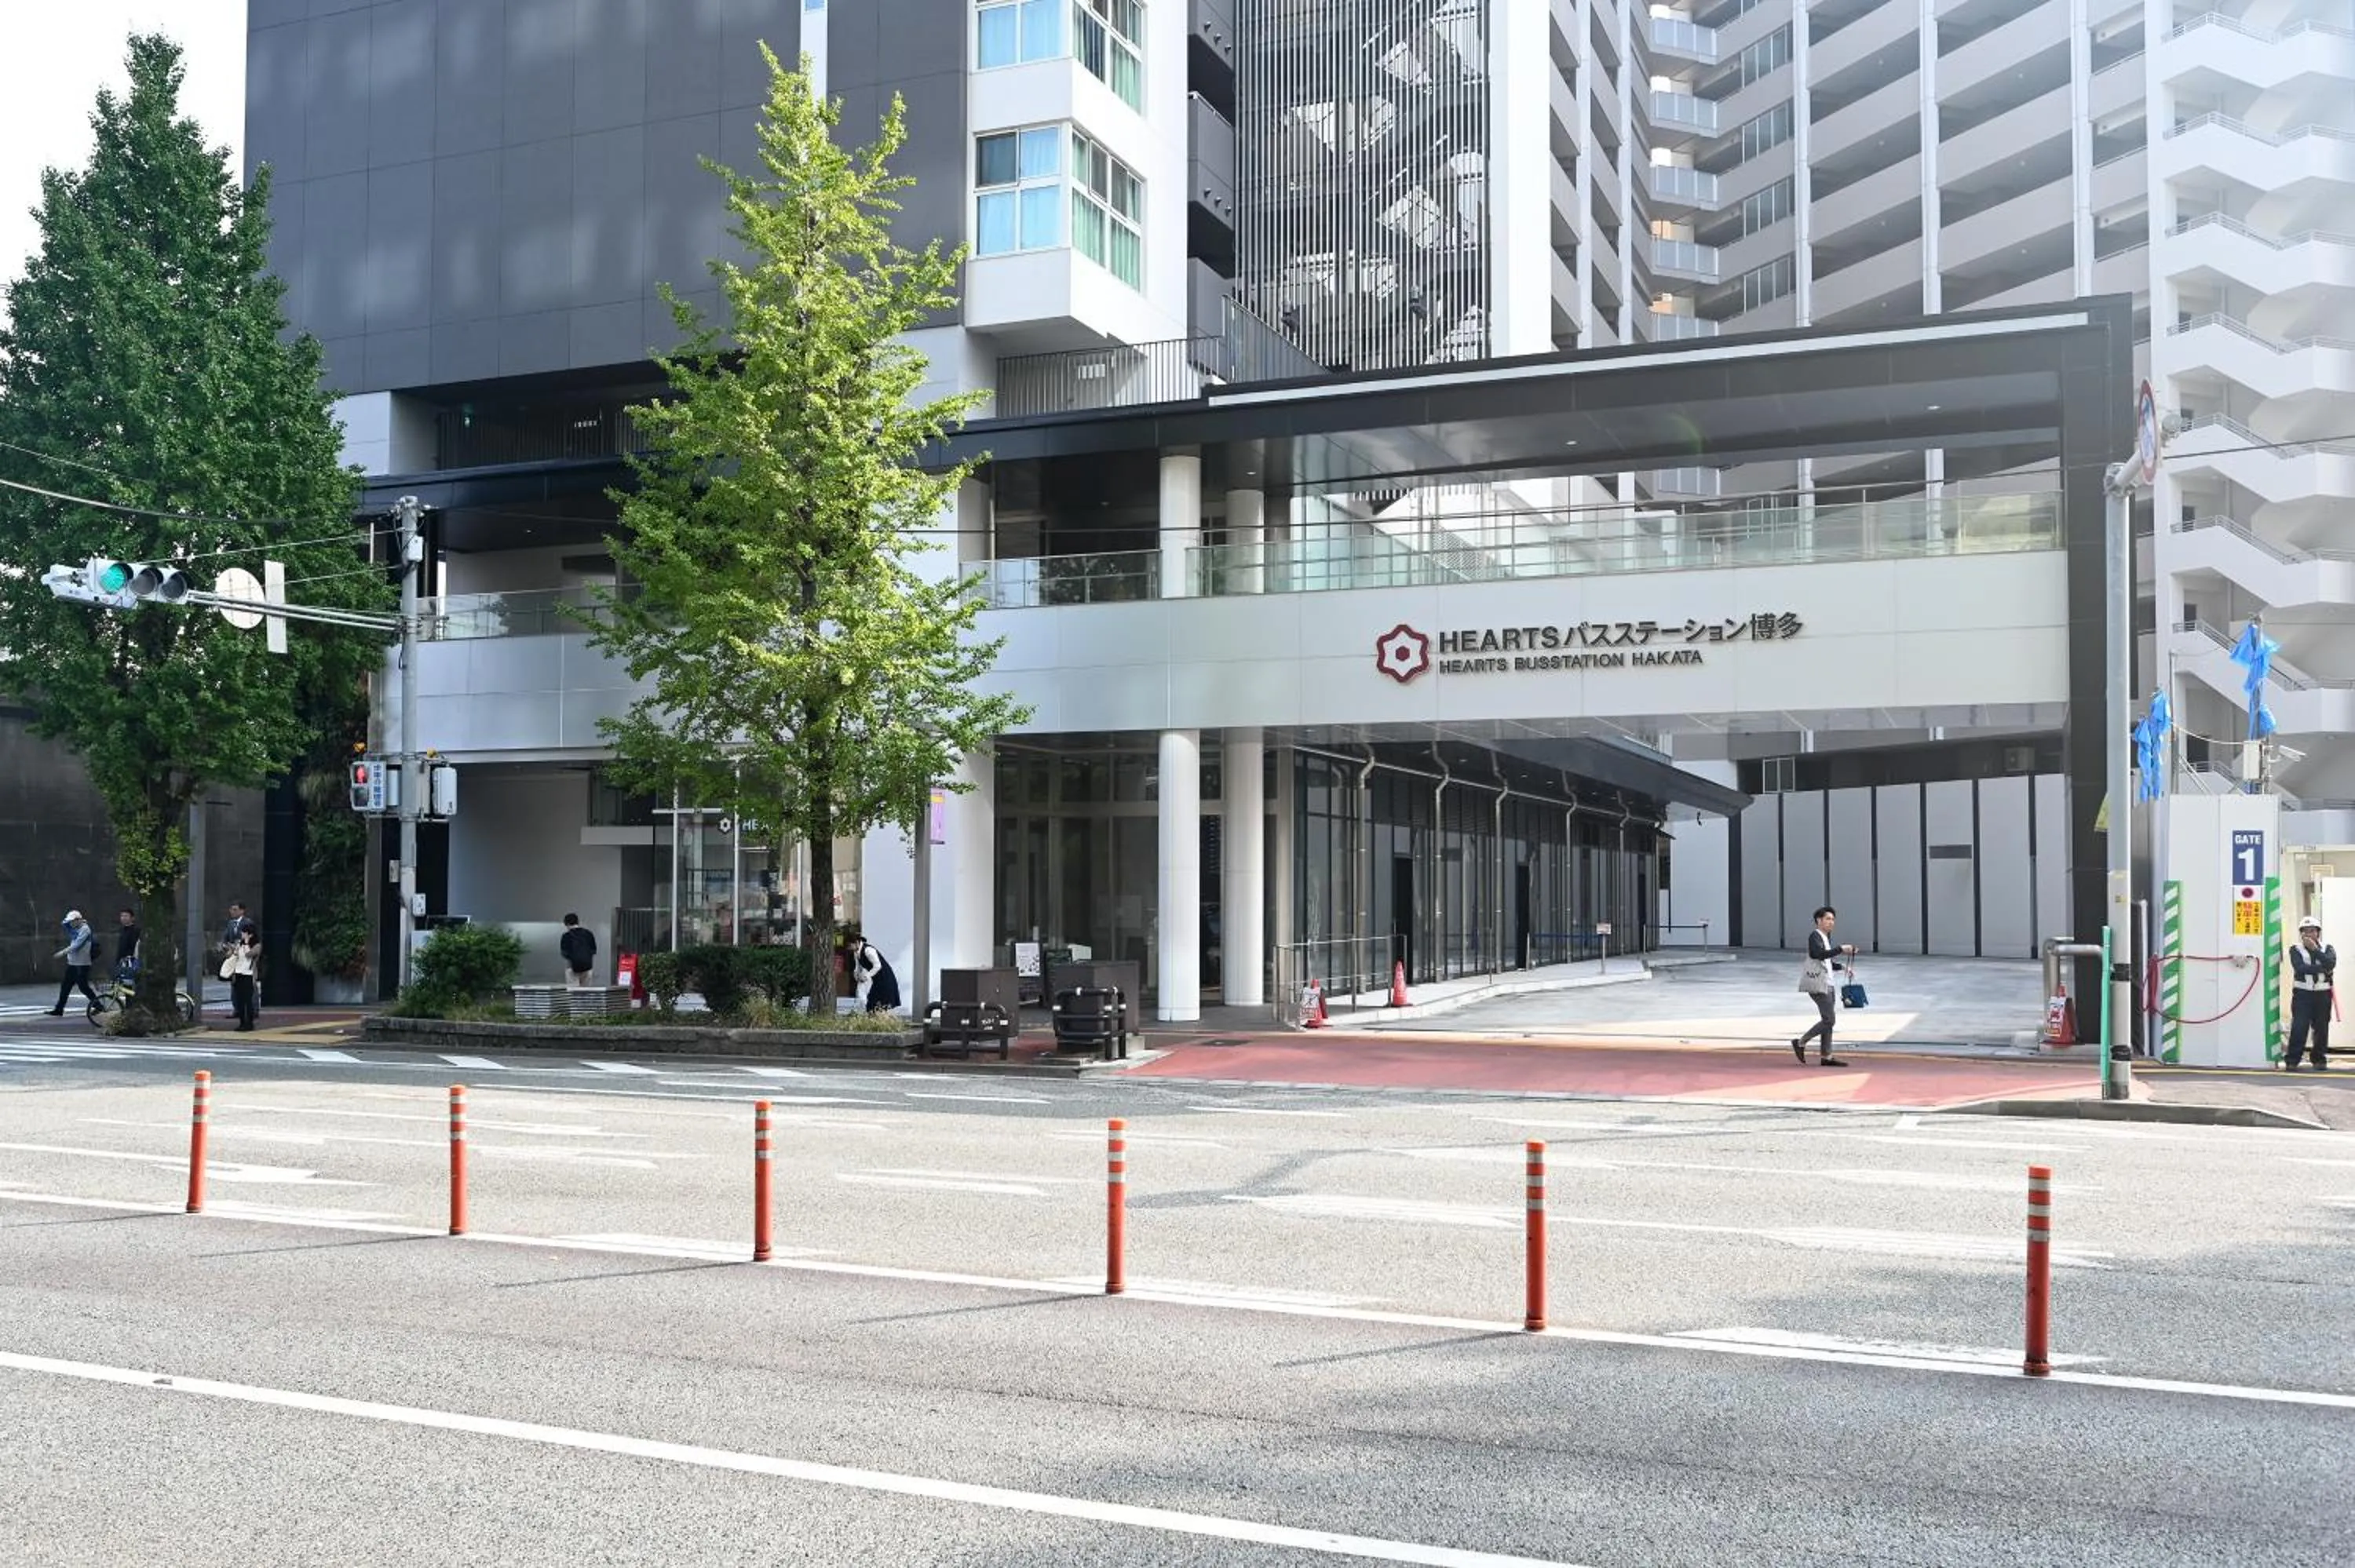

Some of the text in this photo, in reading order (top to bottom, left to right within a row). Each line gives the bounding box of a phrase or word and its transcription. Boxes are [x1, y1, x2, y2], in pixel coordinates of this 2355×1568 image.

[1439, 649, 1703, 674] HEARTS BUSSTATION HAKATA
[2234, 834, 2262, 844] GATE
[2237, 848, 2255, 881] 1
